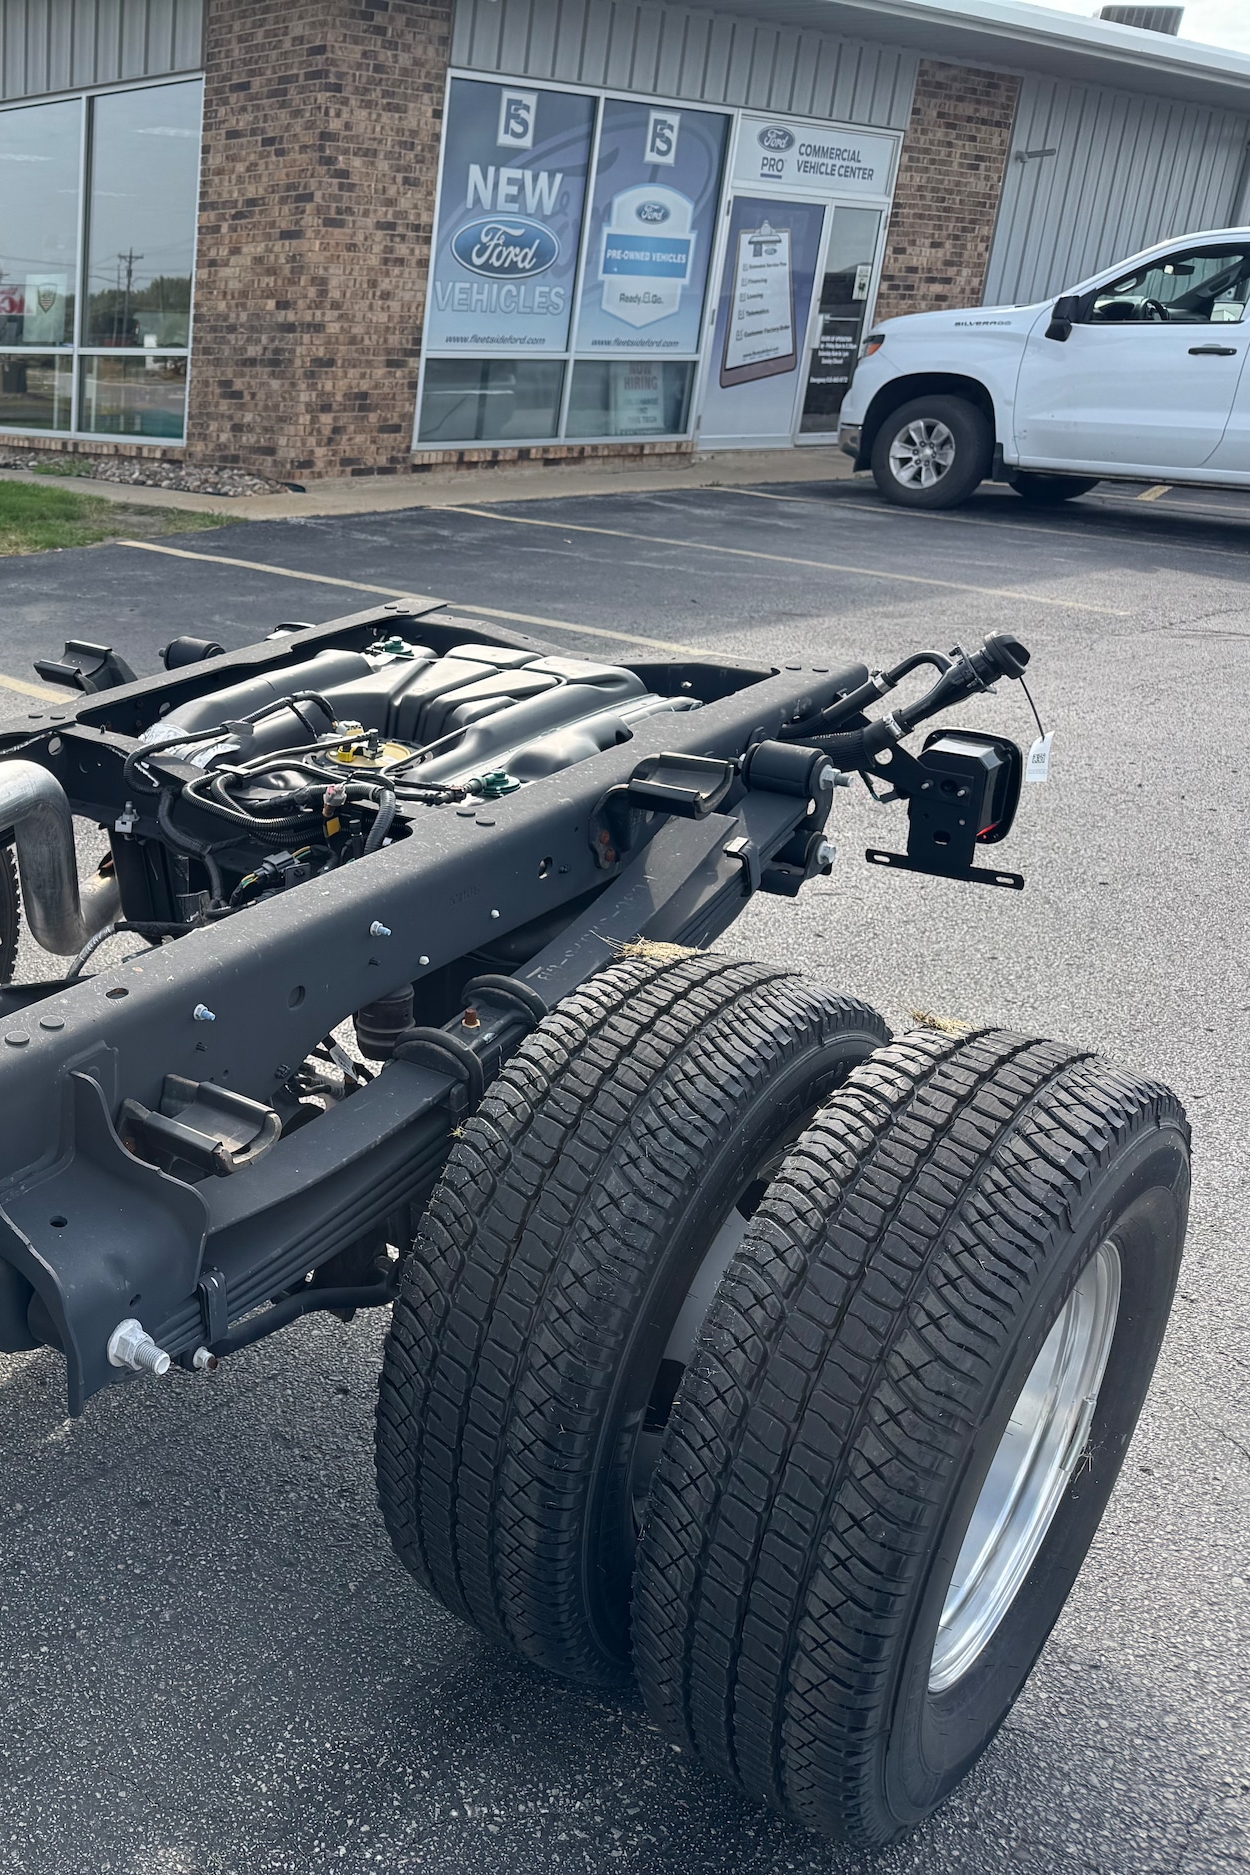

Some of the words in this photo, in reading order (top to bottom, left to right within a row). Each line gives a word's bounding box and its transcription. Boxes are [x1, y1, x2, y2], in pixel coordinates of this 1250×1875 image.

[763, 129, 789, 149] Ford
[798, 143, 862, 163] COMMERCIAL
[760, 156, 784, 173] PRO
[796, 159, 836, 177] VEHICLE
[837, 165, 874, 181] CENTER
[466, 164, 563, 216] NEW
[640, 204, 664, 221] Ford
[471, 223, 541, 270] Ford
[606, 249, 650, 261] PRE-OWNED
[651, 252, 687, 264] VEHICLES
[435, 281, 565, 316] VEHICLES
[445, 333, 546, 346] www.fleetsideford.com
[624, 375, 658, 390] HIRING
